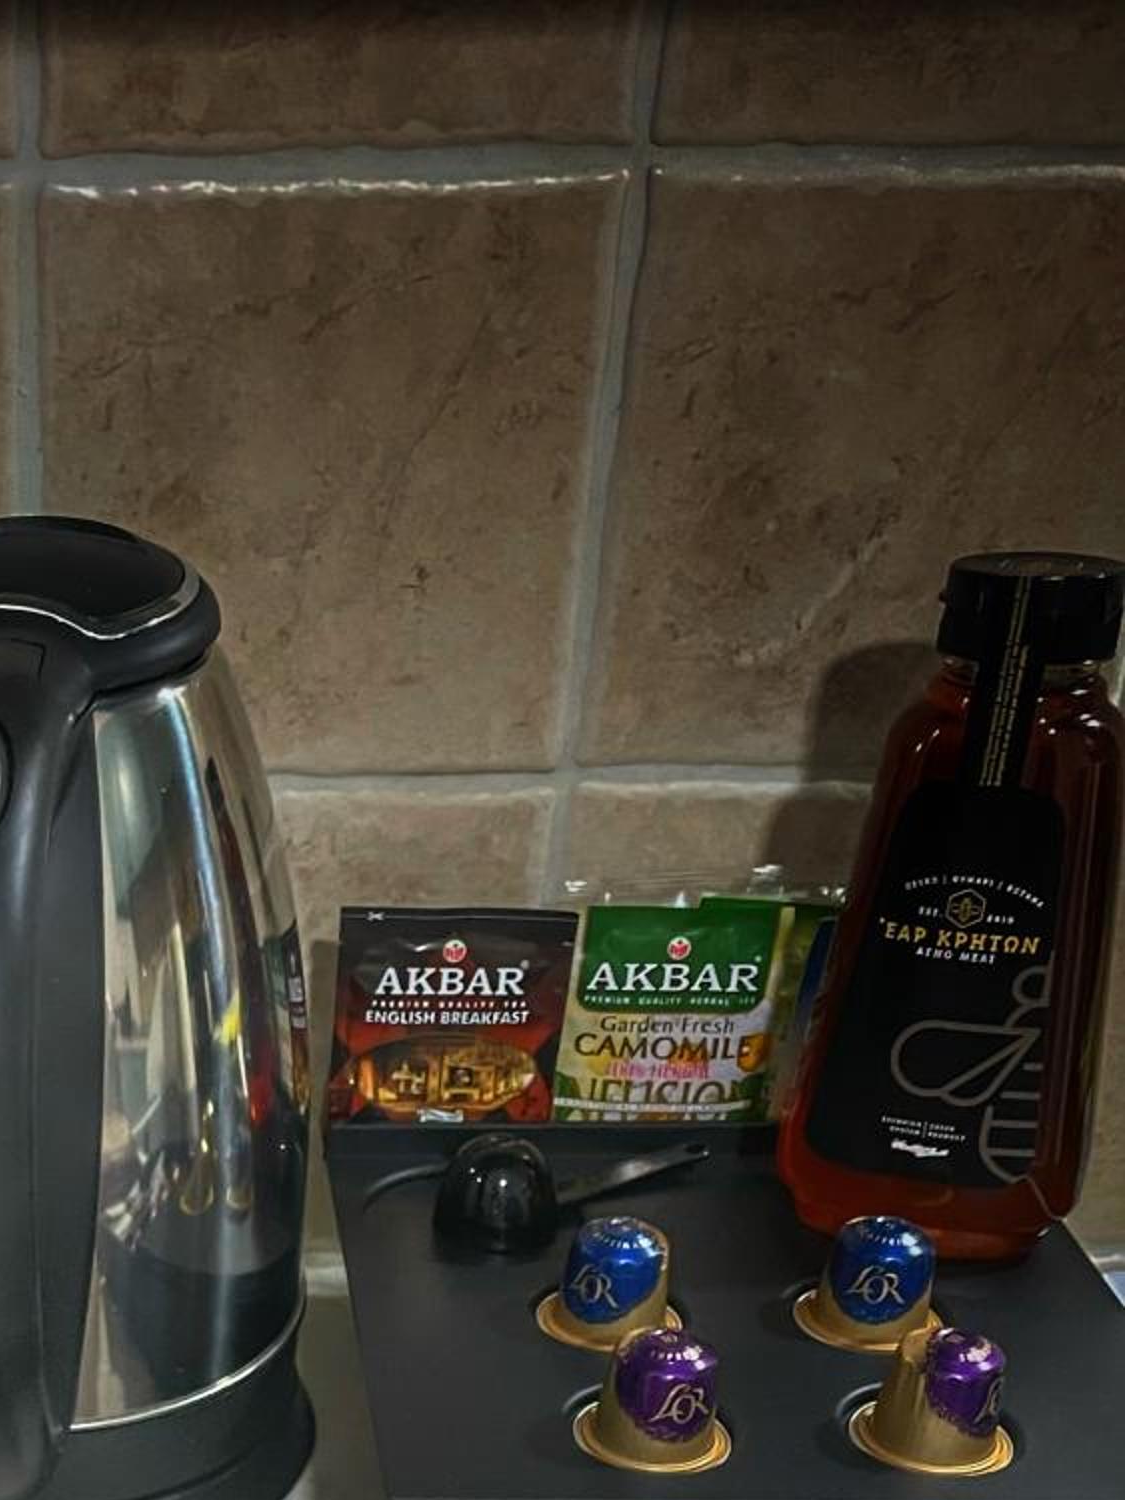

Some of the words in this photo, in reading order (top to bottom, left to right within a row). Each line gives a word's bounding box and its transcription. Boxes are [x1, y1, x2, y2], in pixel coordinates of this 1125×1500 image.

[936, 929, 1041, 954] ΚΡΗΤΩΝ
[375, 967, 524, 995] AKBAR
[587, 962, 759, 992] AKBAR
[365, 1011, 435, 1024] ENGLISH
[440, 1011, 530, 1024] BREAKFAST
[600, 1016, 674, 1033] Garden
[682, 1016, 734, 1033] Fresh
